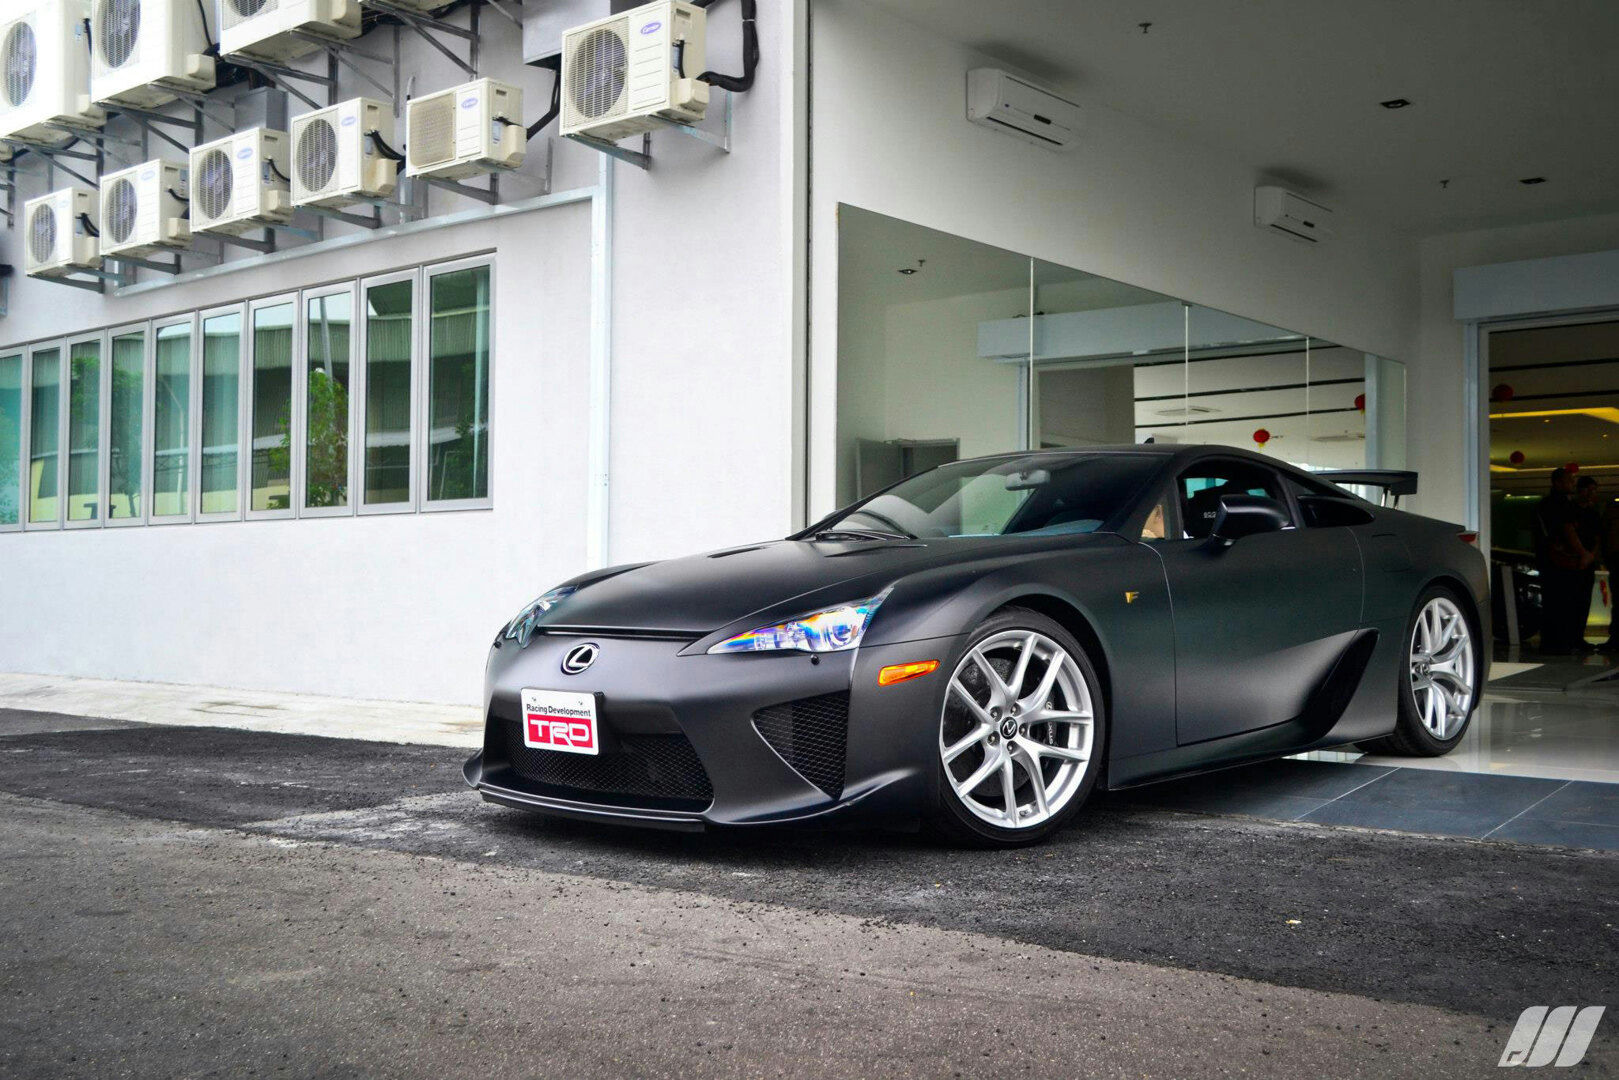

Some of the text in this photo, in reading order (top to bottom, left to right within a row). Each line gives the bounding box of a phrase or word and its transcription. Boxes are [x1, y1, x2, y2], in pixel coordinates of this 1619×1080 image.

[526, 703, 592, 717] Racing Development
[529, 719, 590, 747] TRD
